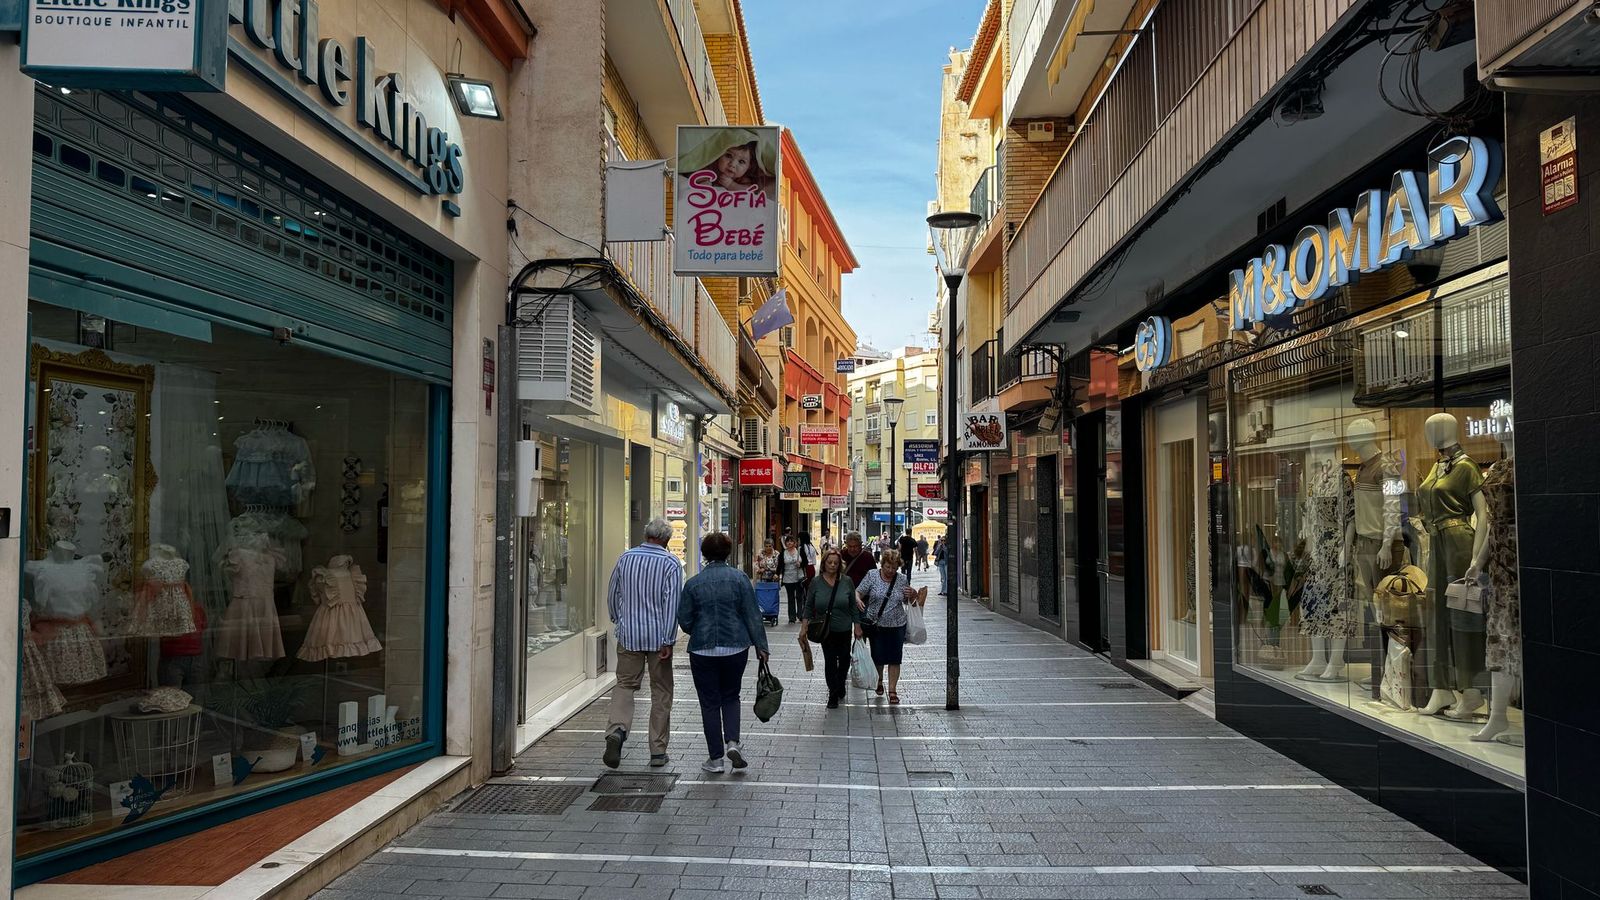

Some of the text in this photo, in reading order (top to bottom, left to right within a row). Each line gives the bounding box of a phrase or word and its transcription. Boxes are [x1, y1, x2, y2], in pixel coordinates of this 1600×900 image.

[35, 15, 189, 29] BOUTIQUE INFANTIL
[356, 36, 464, 195] kings
[1544, 157, 1574, 178] Alarma
[687, 209, 765, 247] BEBÉ
[1229, 136, 1489, 331] M&OMAR
[688, 249, 764, 264] Todo para bebé
[969, 414, 998, 425] BAR
[741, 468, 772, 476] 北京飯店
[914, 462, 934, 470] ALFA
[374, 736, 390, 749] 902
[406, 727, 420, 738] 334
